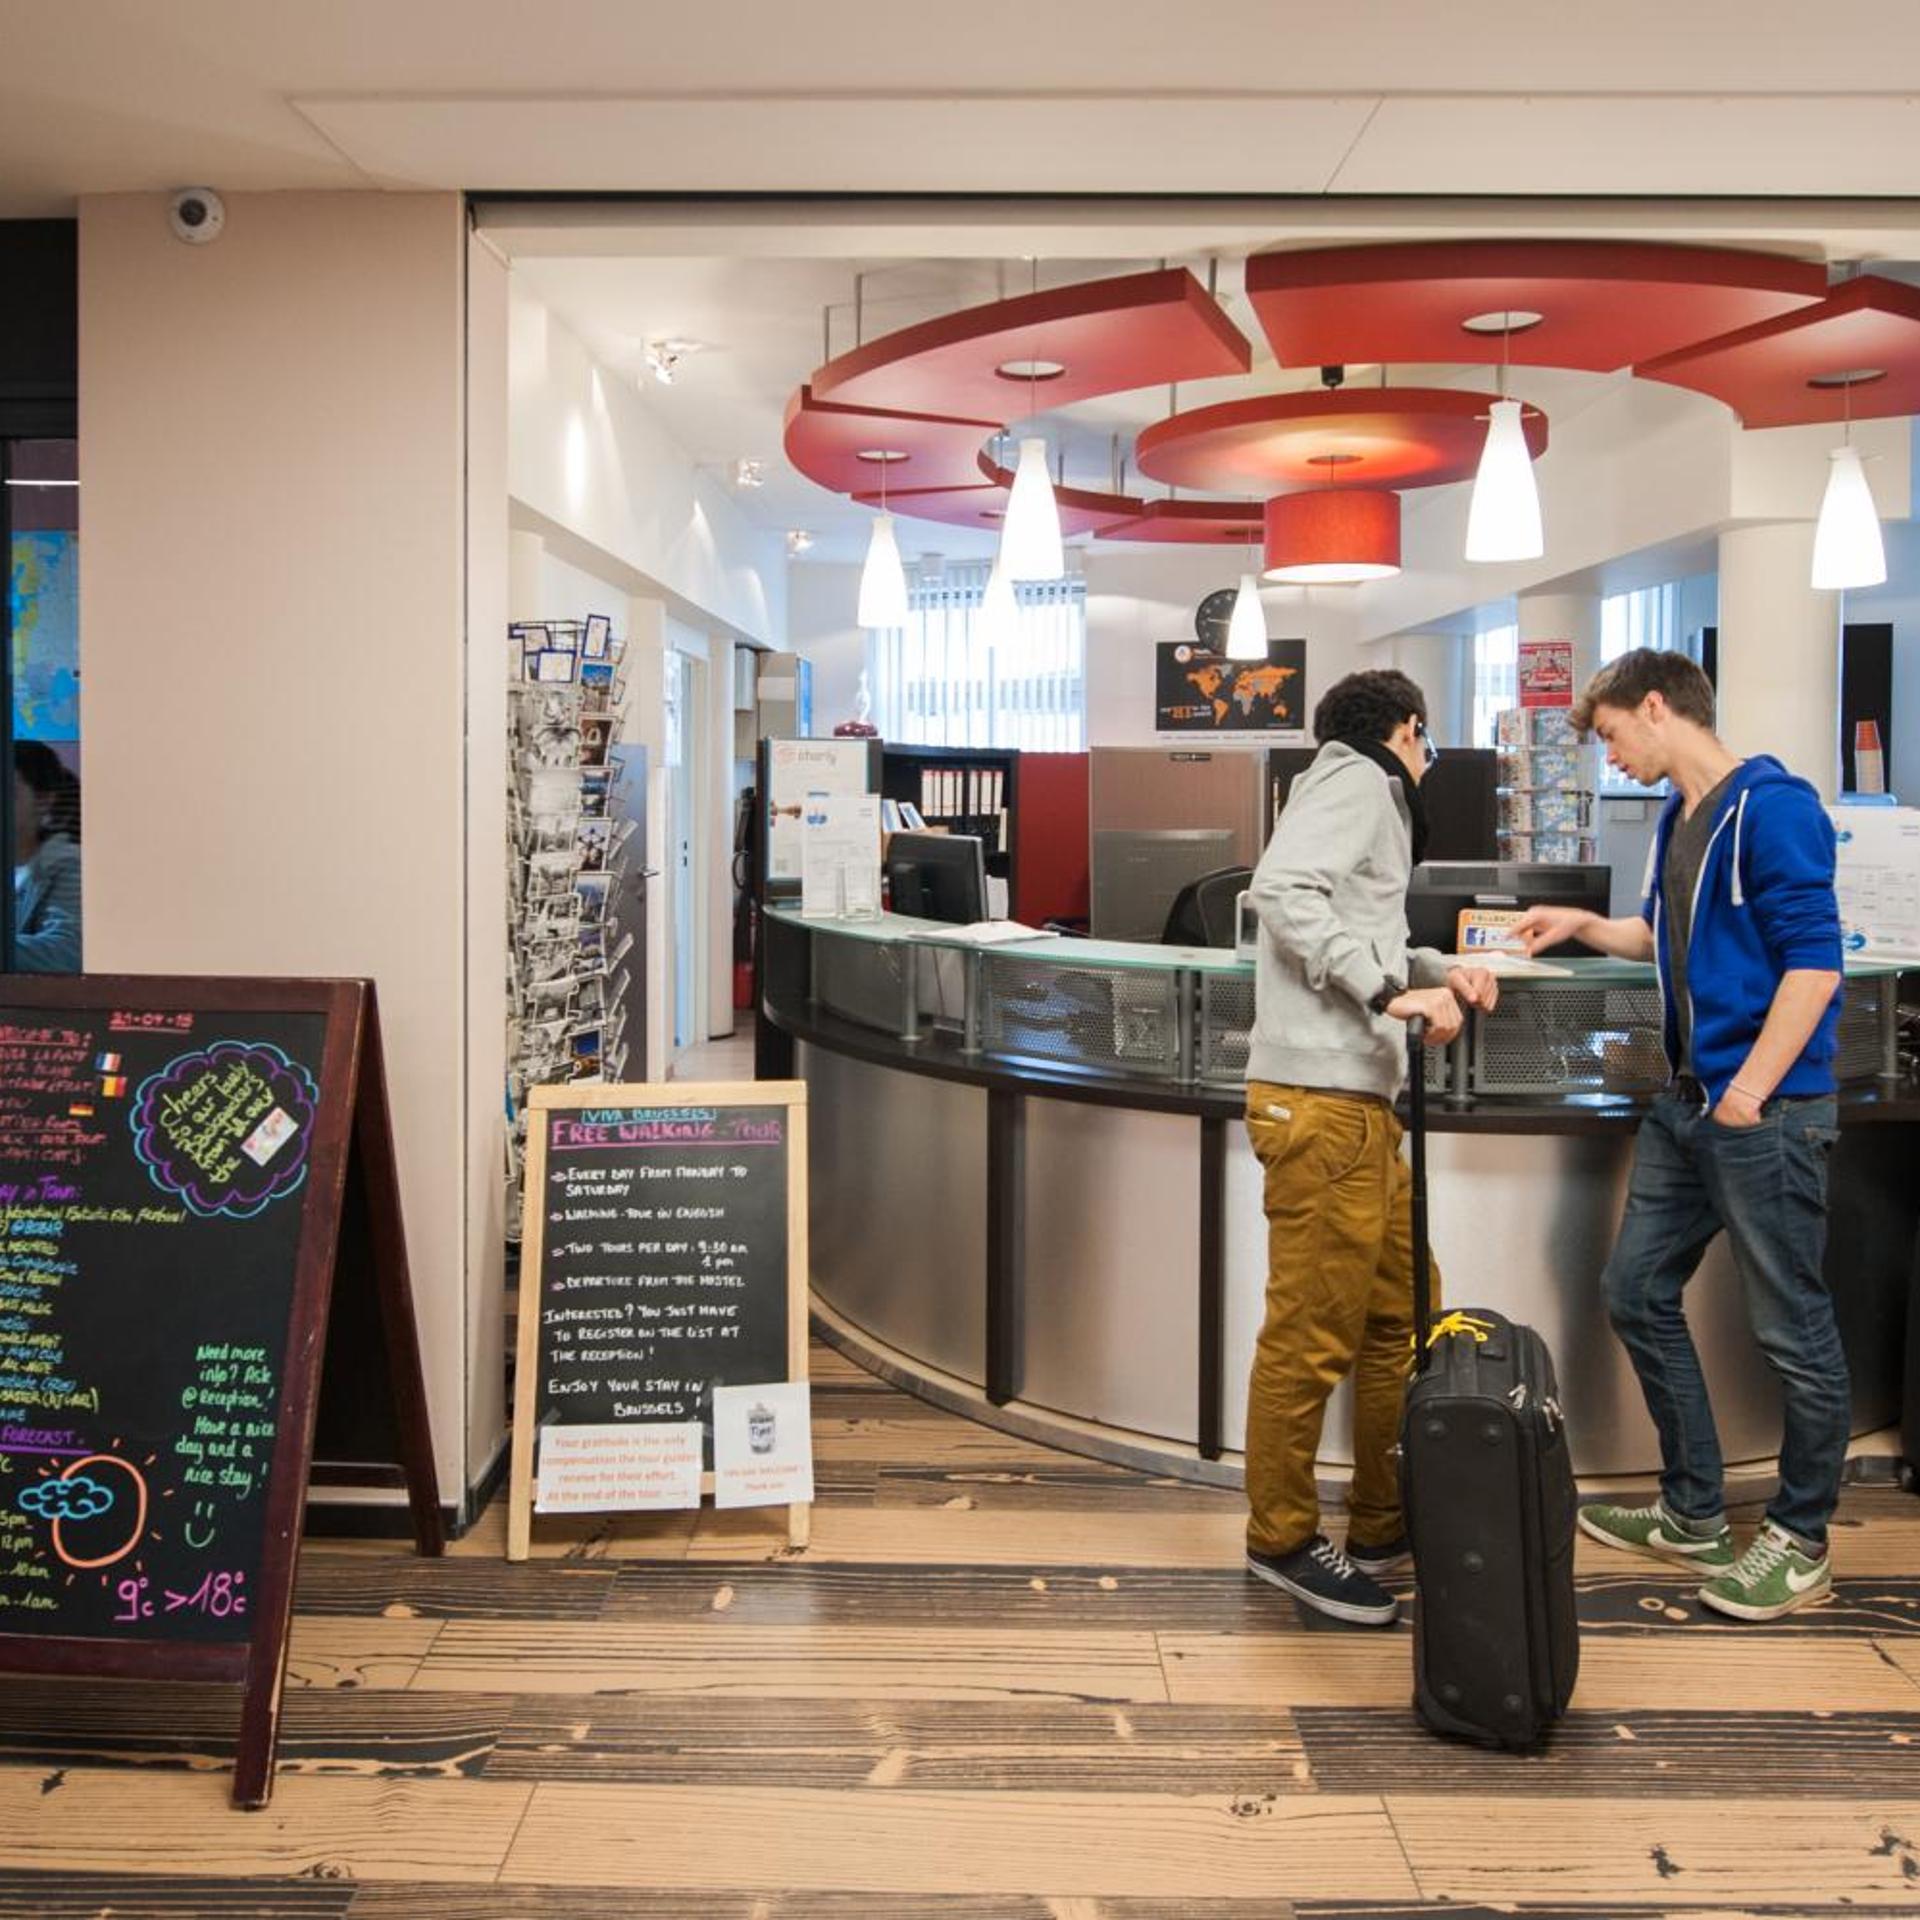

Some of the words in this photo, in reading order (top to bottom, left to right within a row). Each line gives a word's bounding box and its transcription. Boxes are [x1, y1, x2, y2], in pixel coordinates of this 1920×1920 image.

[552, 1119, 608, 1144] FREE
[611, 1167, 635, 1181] DAY
[640, 1165, 671, 1179] FROM
[729, 1166, 749, 1178] TO
[565, 1184, 631, 1198] SATURDAY
[638, 1242, 661, 1254] PER
[638, 1274, 669, 1287] FROM
[699, 1304, 740, 1318] HAVE
[553, 1329, 572, 1344] TO
[658, 1326, 684, 1339] THE
[720, 1325, 741, 1339] AT
[196, 1343, 228, 1362] Need
[230, 1348, 265, 1362] more
[550, 1349, 576, 1364] THE
[548, 1379, 599, 1395] ENJOY
[607, 1379, 641, 1393] YOUR
[645, 1378, 681, 1393] STAY
[194, 1415, 226, 1436] Have
[229, 1423, 241, 1436] a
[246, 1420, 275, 1437] nice
[175, 1434, 203, 1465] day
[208, 1439, 237, 1457] and
[241, 1445, 253, 1458] a
[184, 1465, 214, 1484] nice
